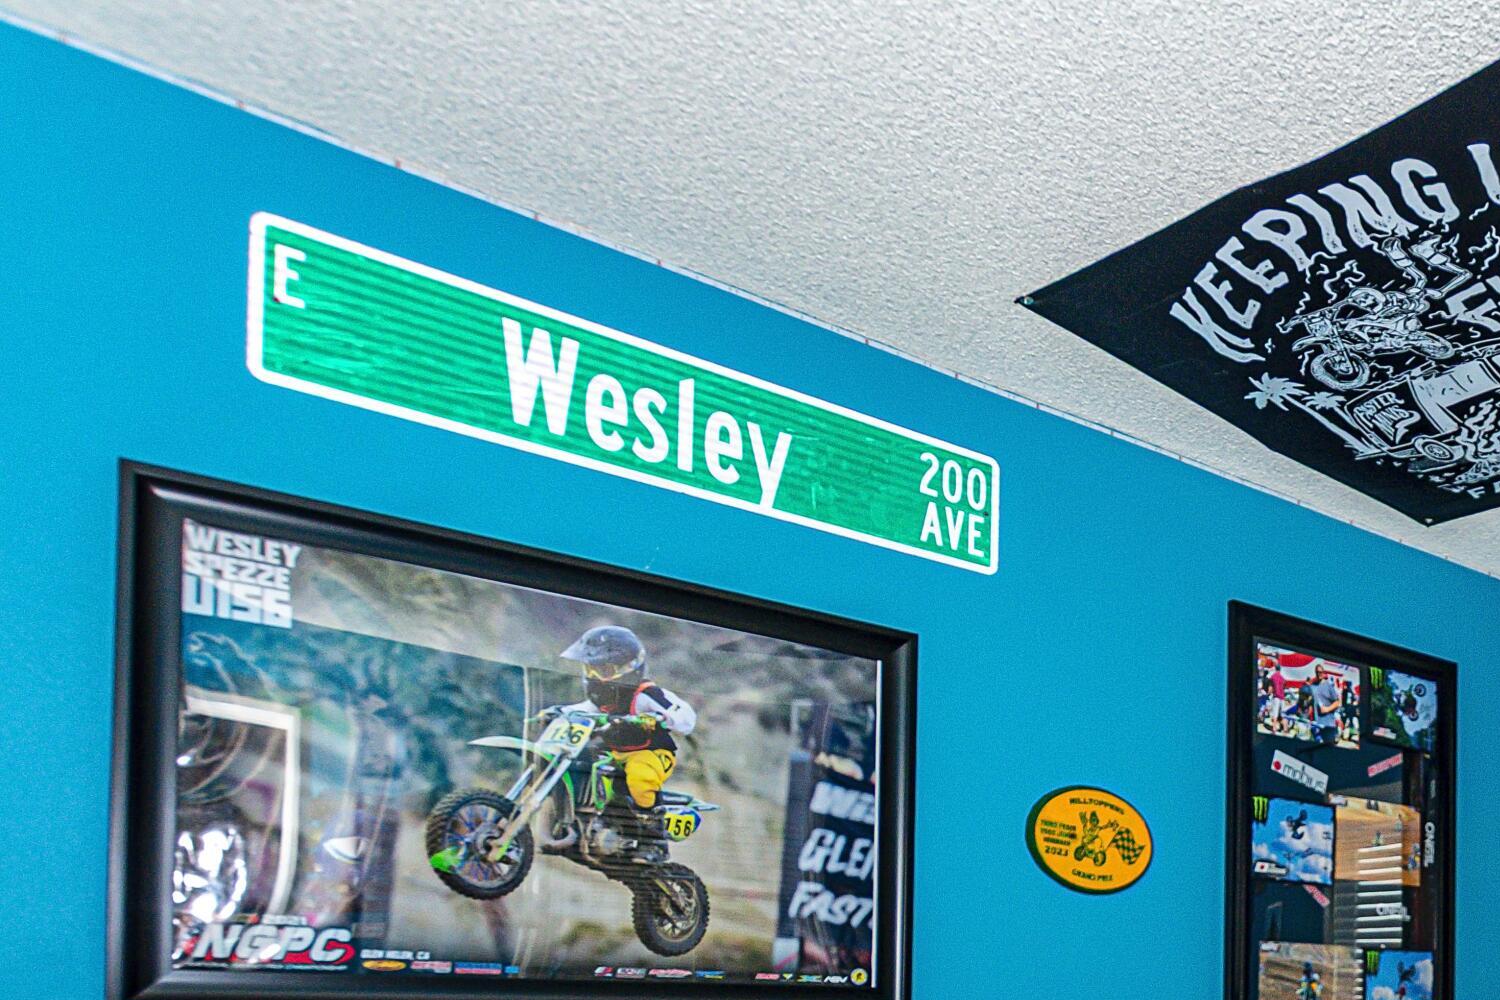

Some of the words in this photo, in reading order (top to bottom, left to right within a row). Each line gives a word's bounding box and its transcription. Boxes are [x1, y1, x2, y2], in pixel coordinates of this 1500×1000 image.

[273, 243, 307, 310] E
[1168, 158, 1461, 365] KEEPING
[501, 315, 793, 508] Wesley
[920, 451, 988, 513] 200
[183, 519, 301, 569] WESLEY
[920, 511, 988, 558] AVE
[192, 924, 352, 962] NGPC
